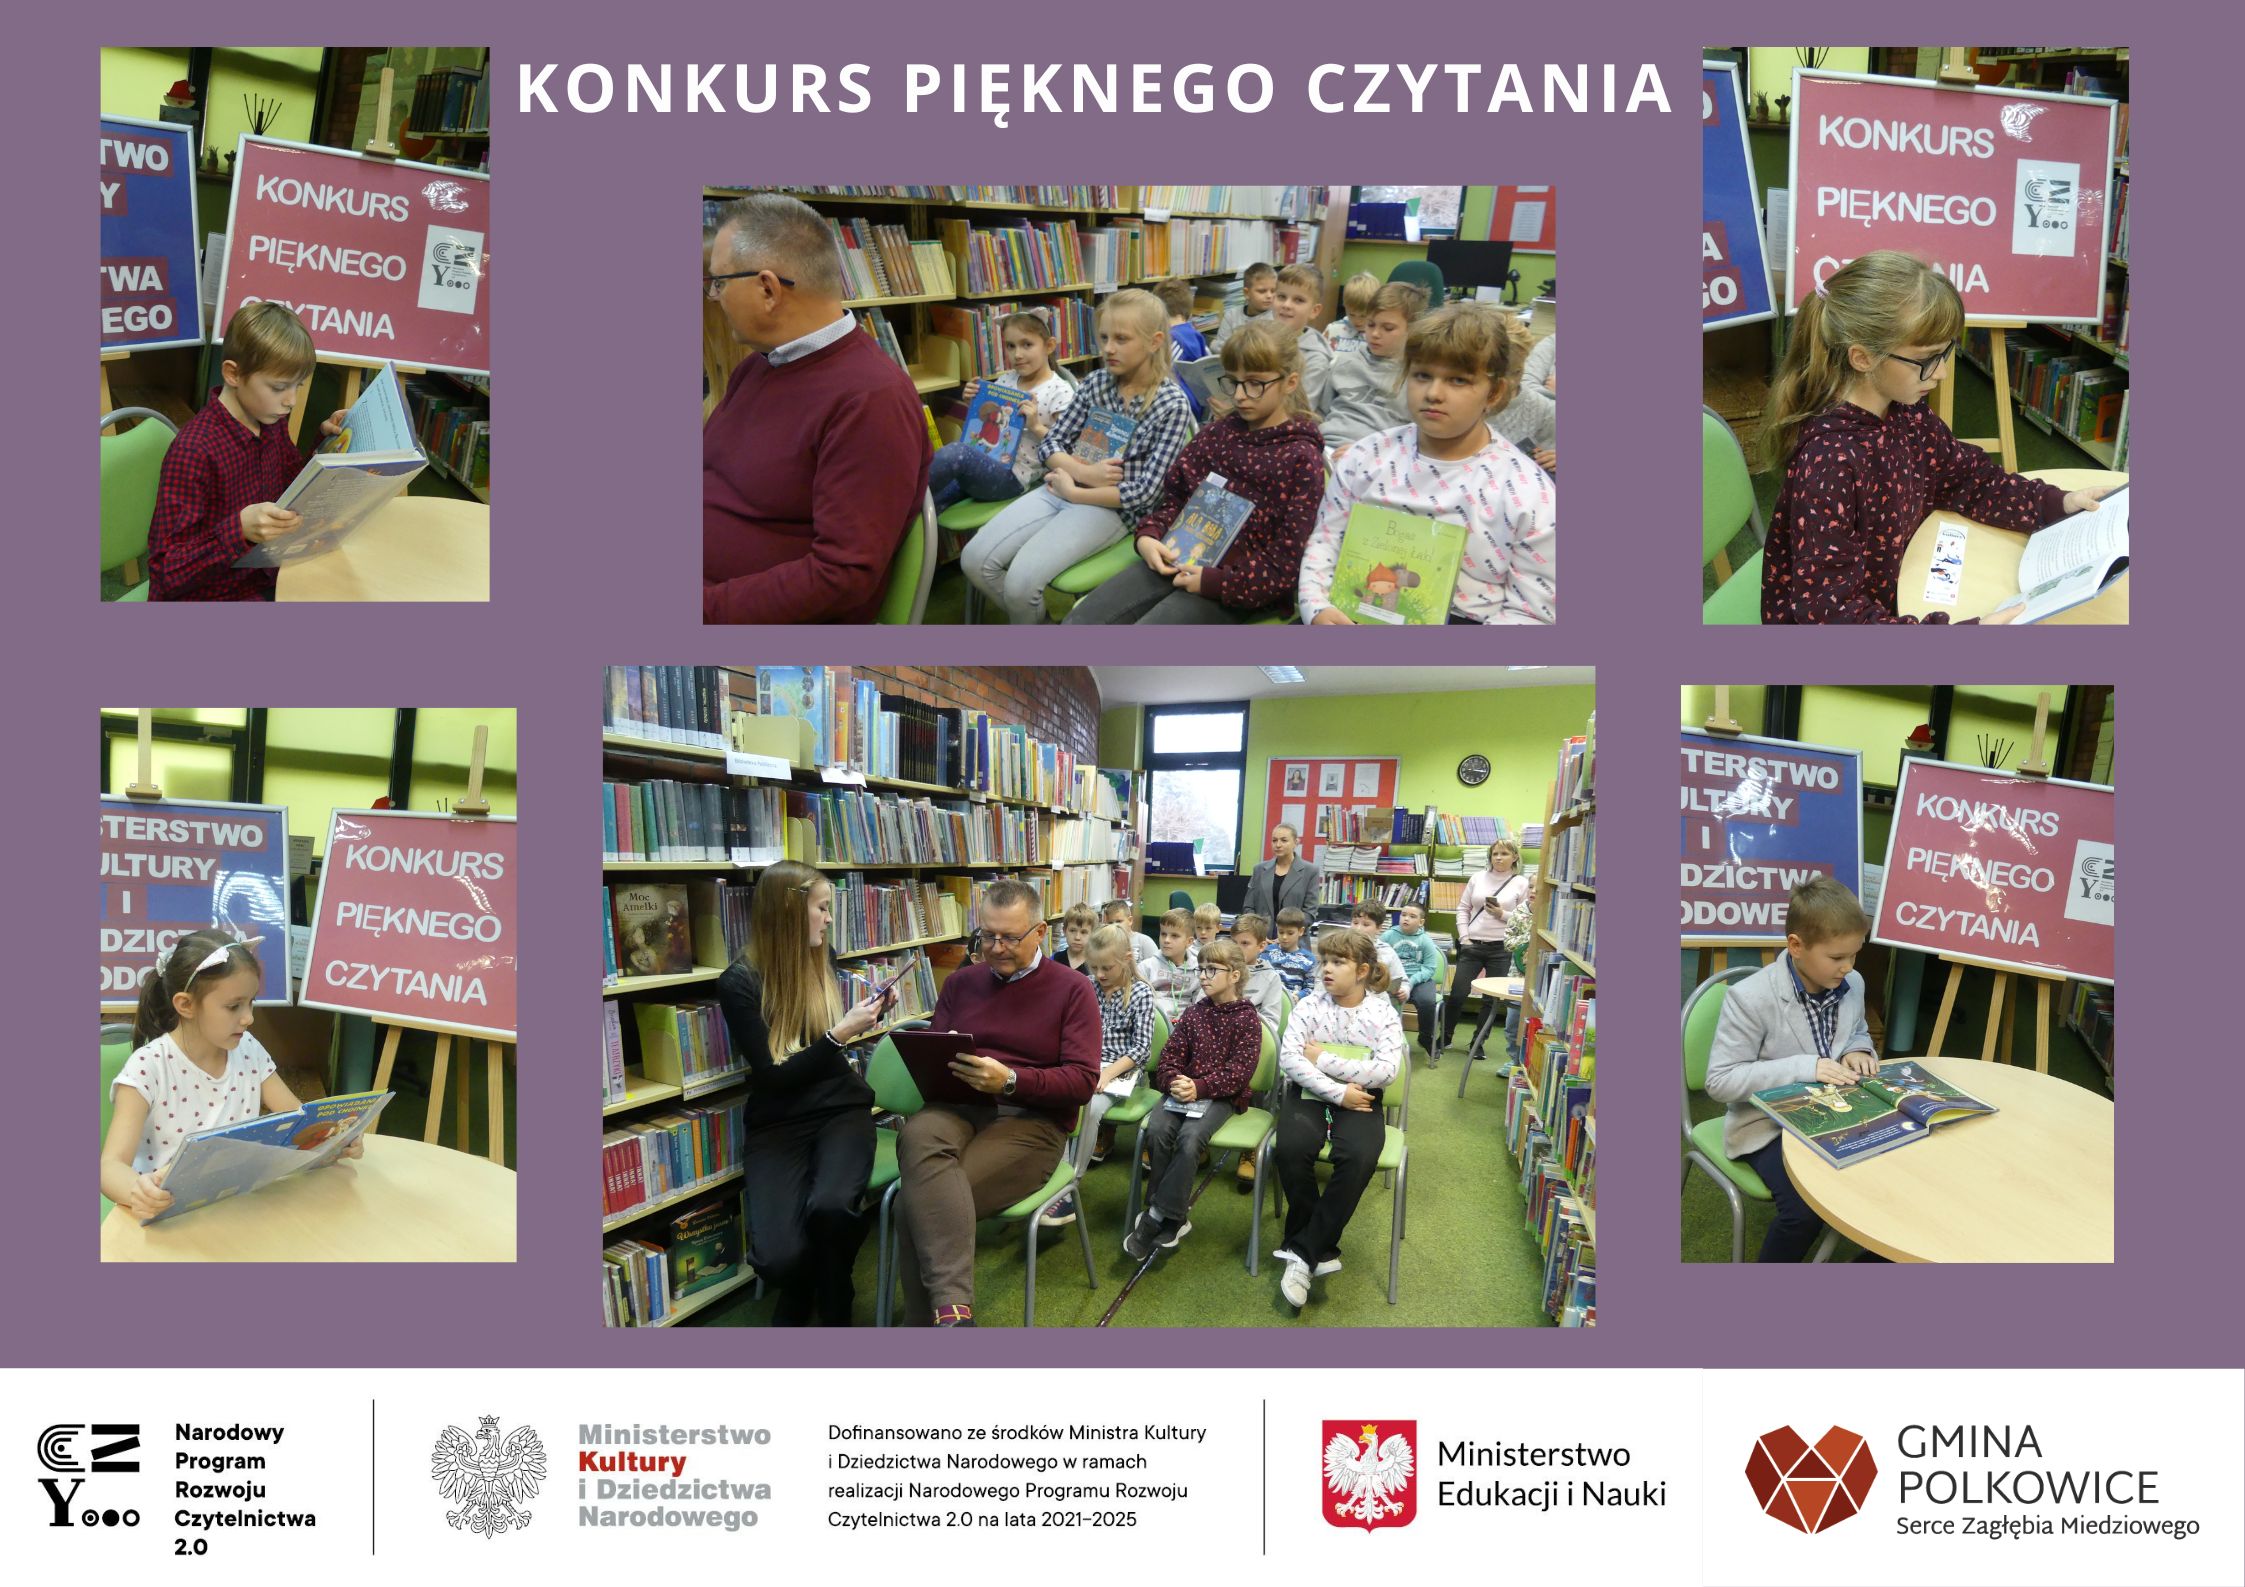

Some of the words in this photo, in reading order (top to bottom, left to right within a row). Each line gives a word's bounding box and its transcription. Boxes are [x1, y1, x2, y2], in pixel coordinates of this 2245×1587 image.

[1819, 114, 1995, 159] KONKURS
[256, 174, 410, 222] KONKURS
[1817, 186, 1997, 228] PIĘKNEGO
[248, 235, 407, 281] PIĘKNEGO
[101, 815, 264, 848] TERSTWO
[1917, 792, 2060, 837] KONKURS
[345, 844, 505, 880] KONKURS
[1906, 847, 2055, 894] PIĘKNEGO
[623, 902, 658, 912] Amelki
[629, 893, 650, 901] Moc
[336, 901, 502, 943] PIĘKNEGO
[1895, 901, 2041, 948] CZYTANIA
[325, 960, 488, 1006] CZYTANIA
